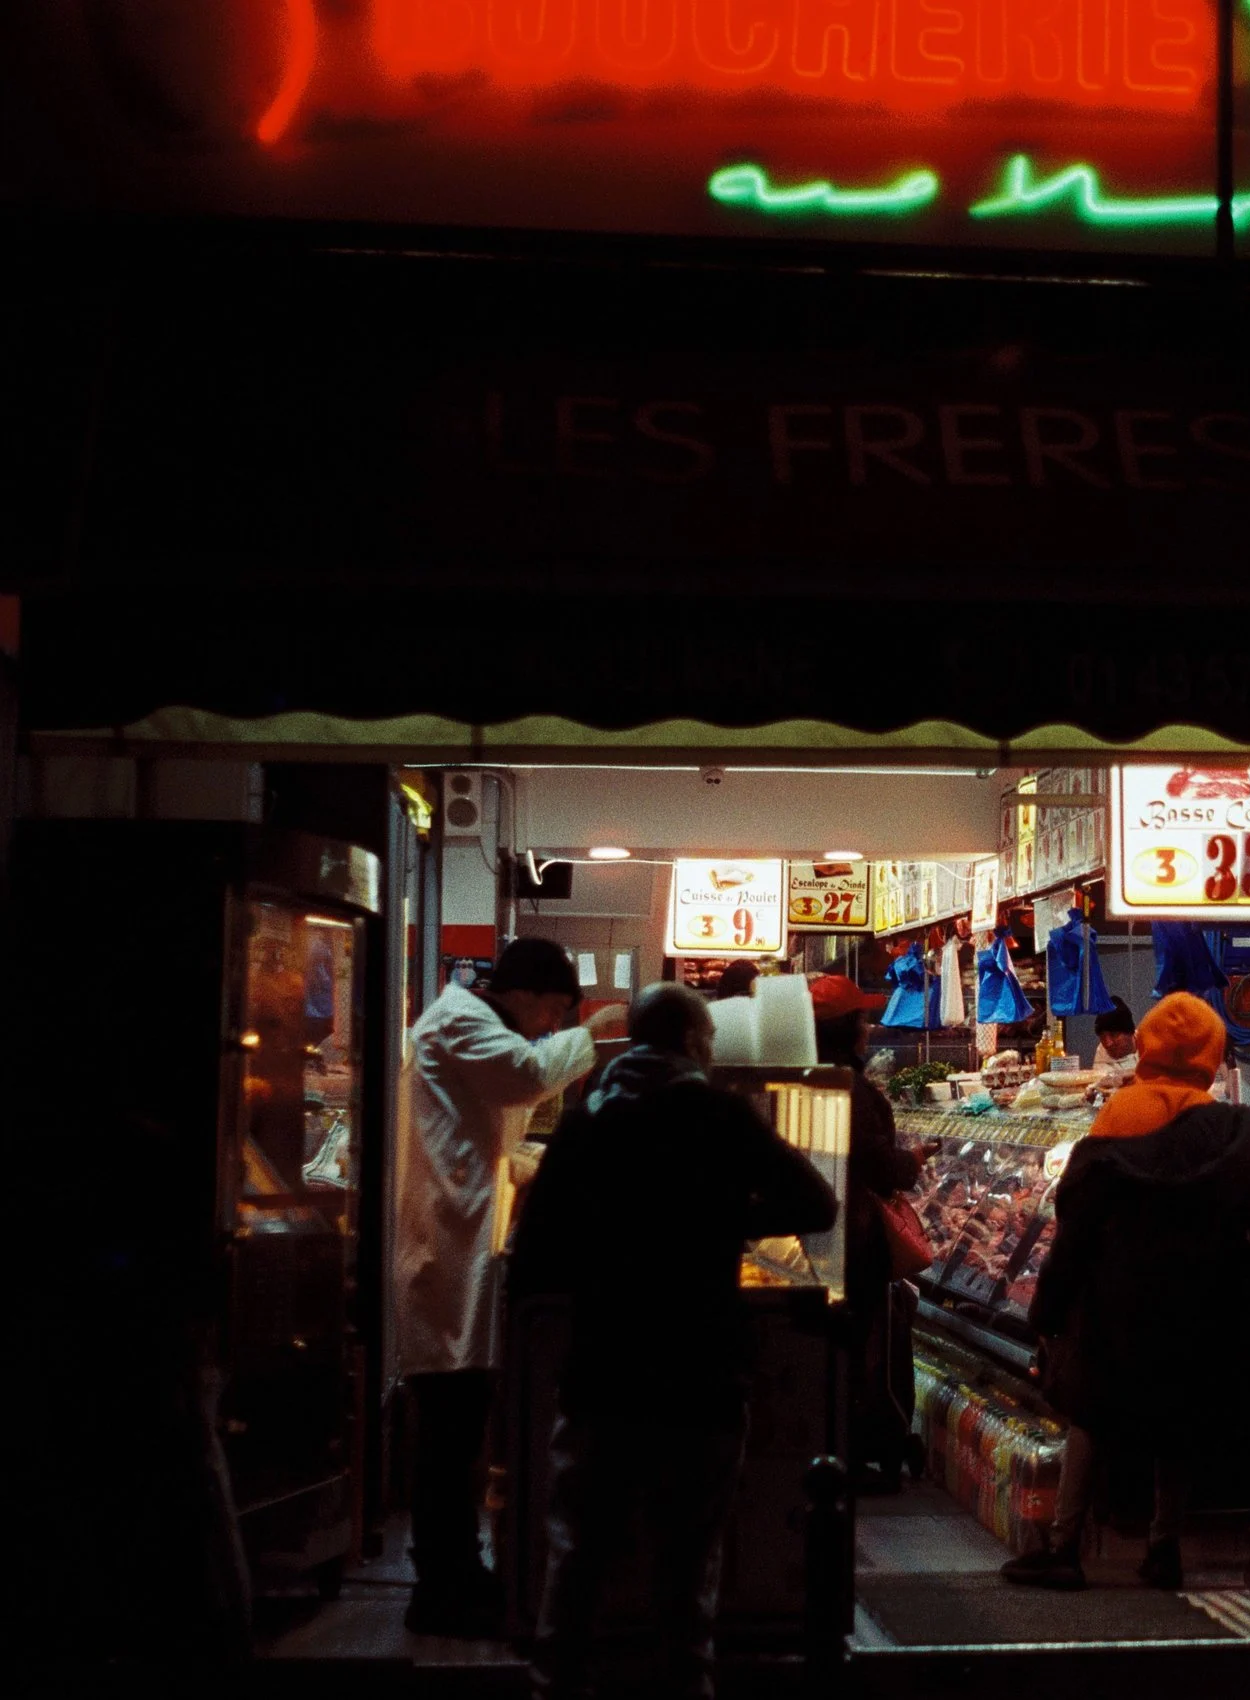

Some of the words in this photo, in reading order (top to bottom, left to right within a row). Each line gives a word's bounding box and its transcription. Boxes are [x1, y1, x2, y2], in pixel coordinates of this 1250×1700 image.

[477, 388, 714, 483] LES
[1139, 800, 1215, 830] Basse
[1155, 849, 1177, 884] 3
[736, 890, 778, 906] Poulet
[791, 877, 829, 890] Escalope
[801, 896, 813, 916] 3
[823, 892, 856, 924] 27
[702, 915, 714, 937] 3
[732, 908, 755, 947] 9
